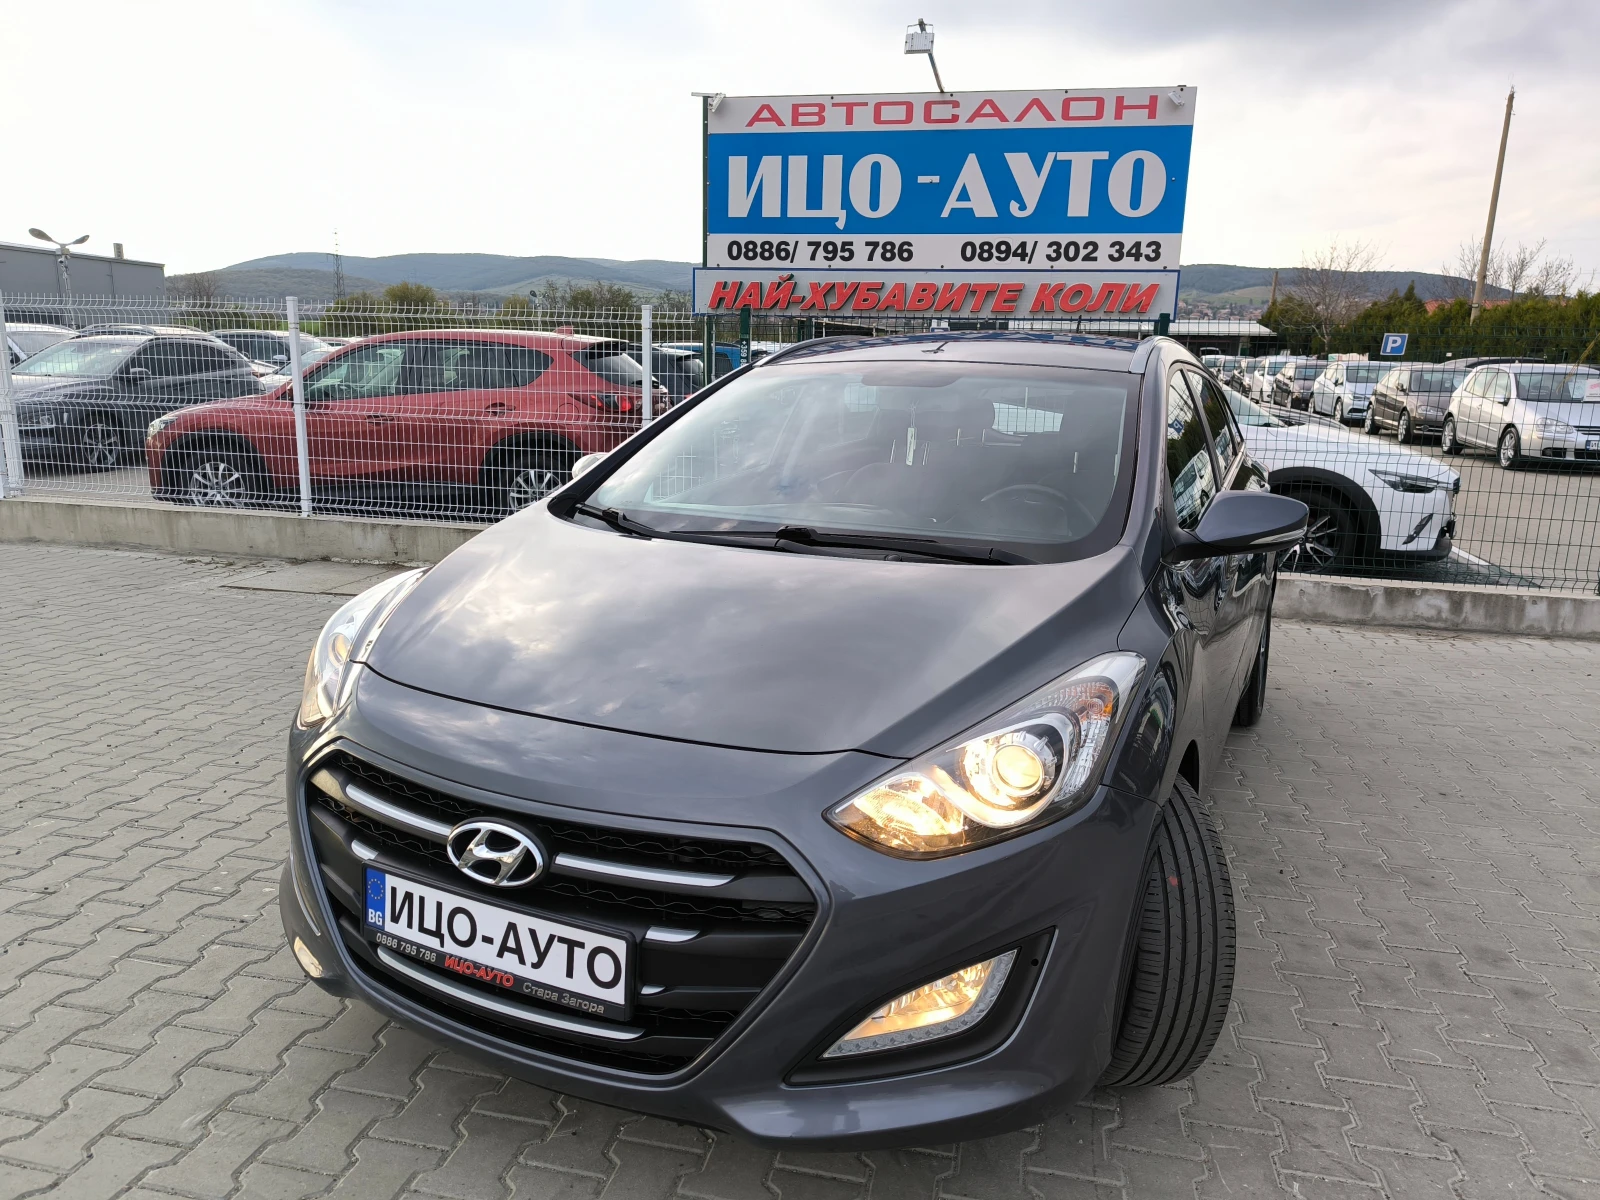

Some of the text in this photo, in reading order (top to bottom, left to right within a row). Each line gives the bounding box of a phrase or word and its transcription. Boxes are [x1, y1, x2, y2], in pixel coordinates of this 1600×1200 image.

[746, 95, 1158, 127] АВТОСАЛОН
[727, 240, 1162, 264] 0886/ 795 786 0894/ 302 343
[708, 273, 1161, 314] НАЙ-ХУБАВИТЕ КОЛИ
[1386, 336, 1402, 353] P
[368, 909, 383, 926] BG
[390, 886, 623, 990] ИЦО-АУТО
[376, 933, 605, 1014] 0886 795 786 ИЦО-АУТО Стара Загора
